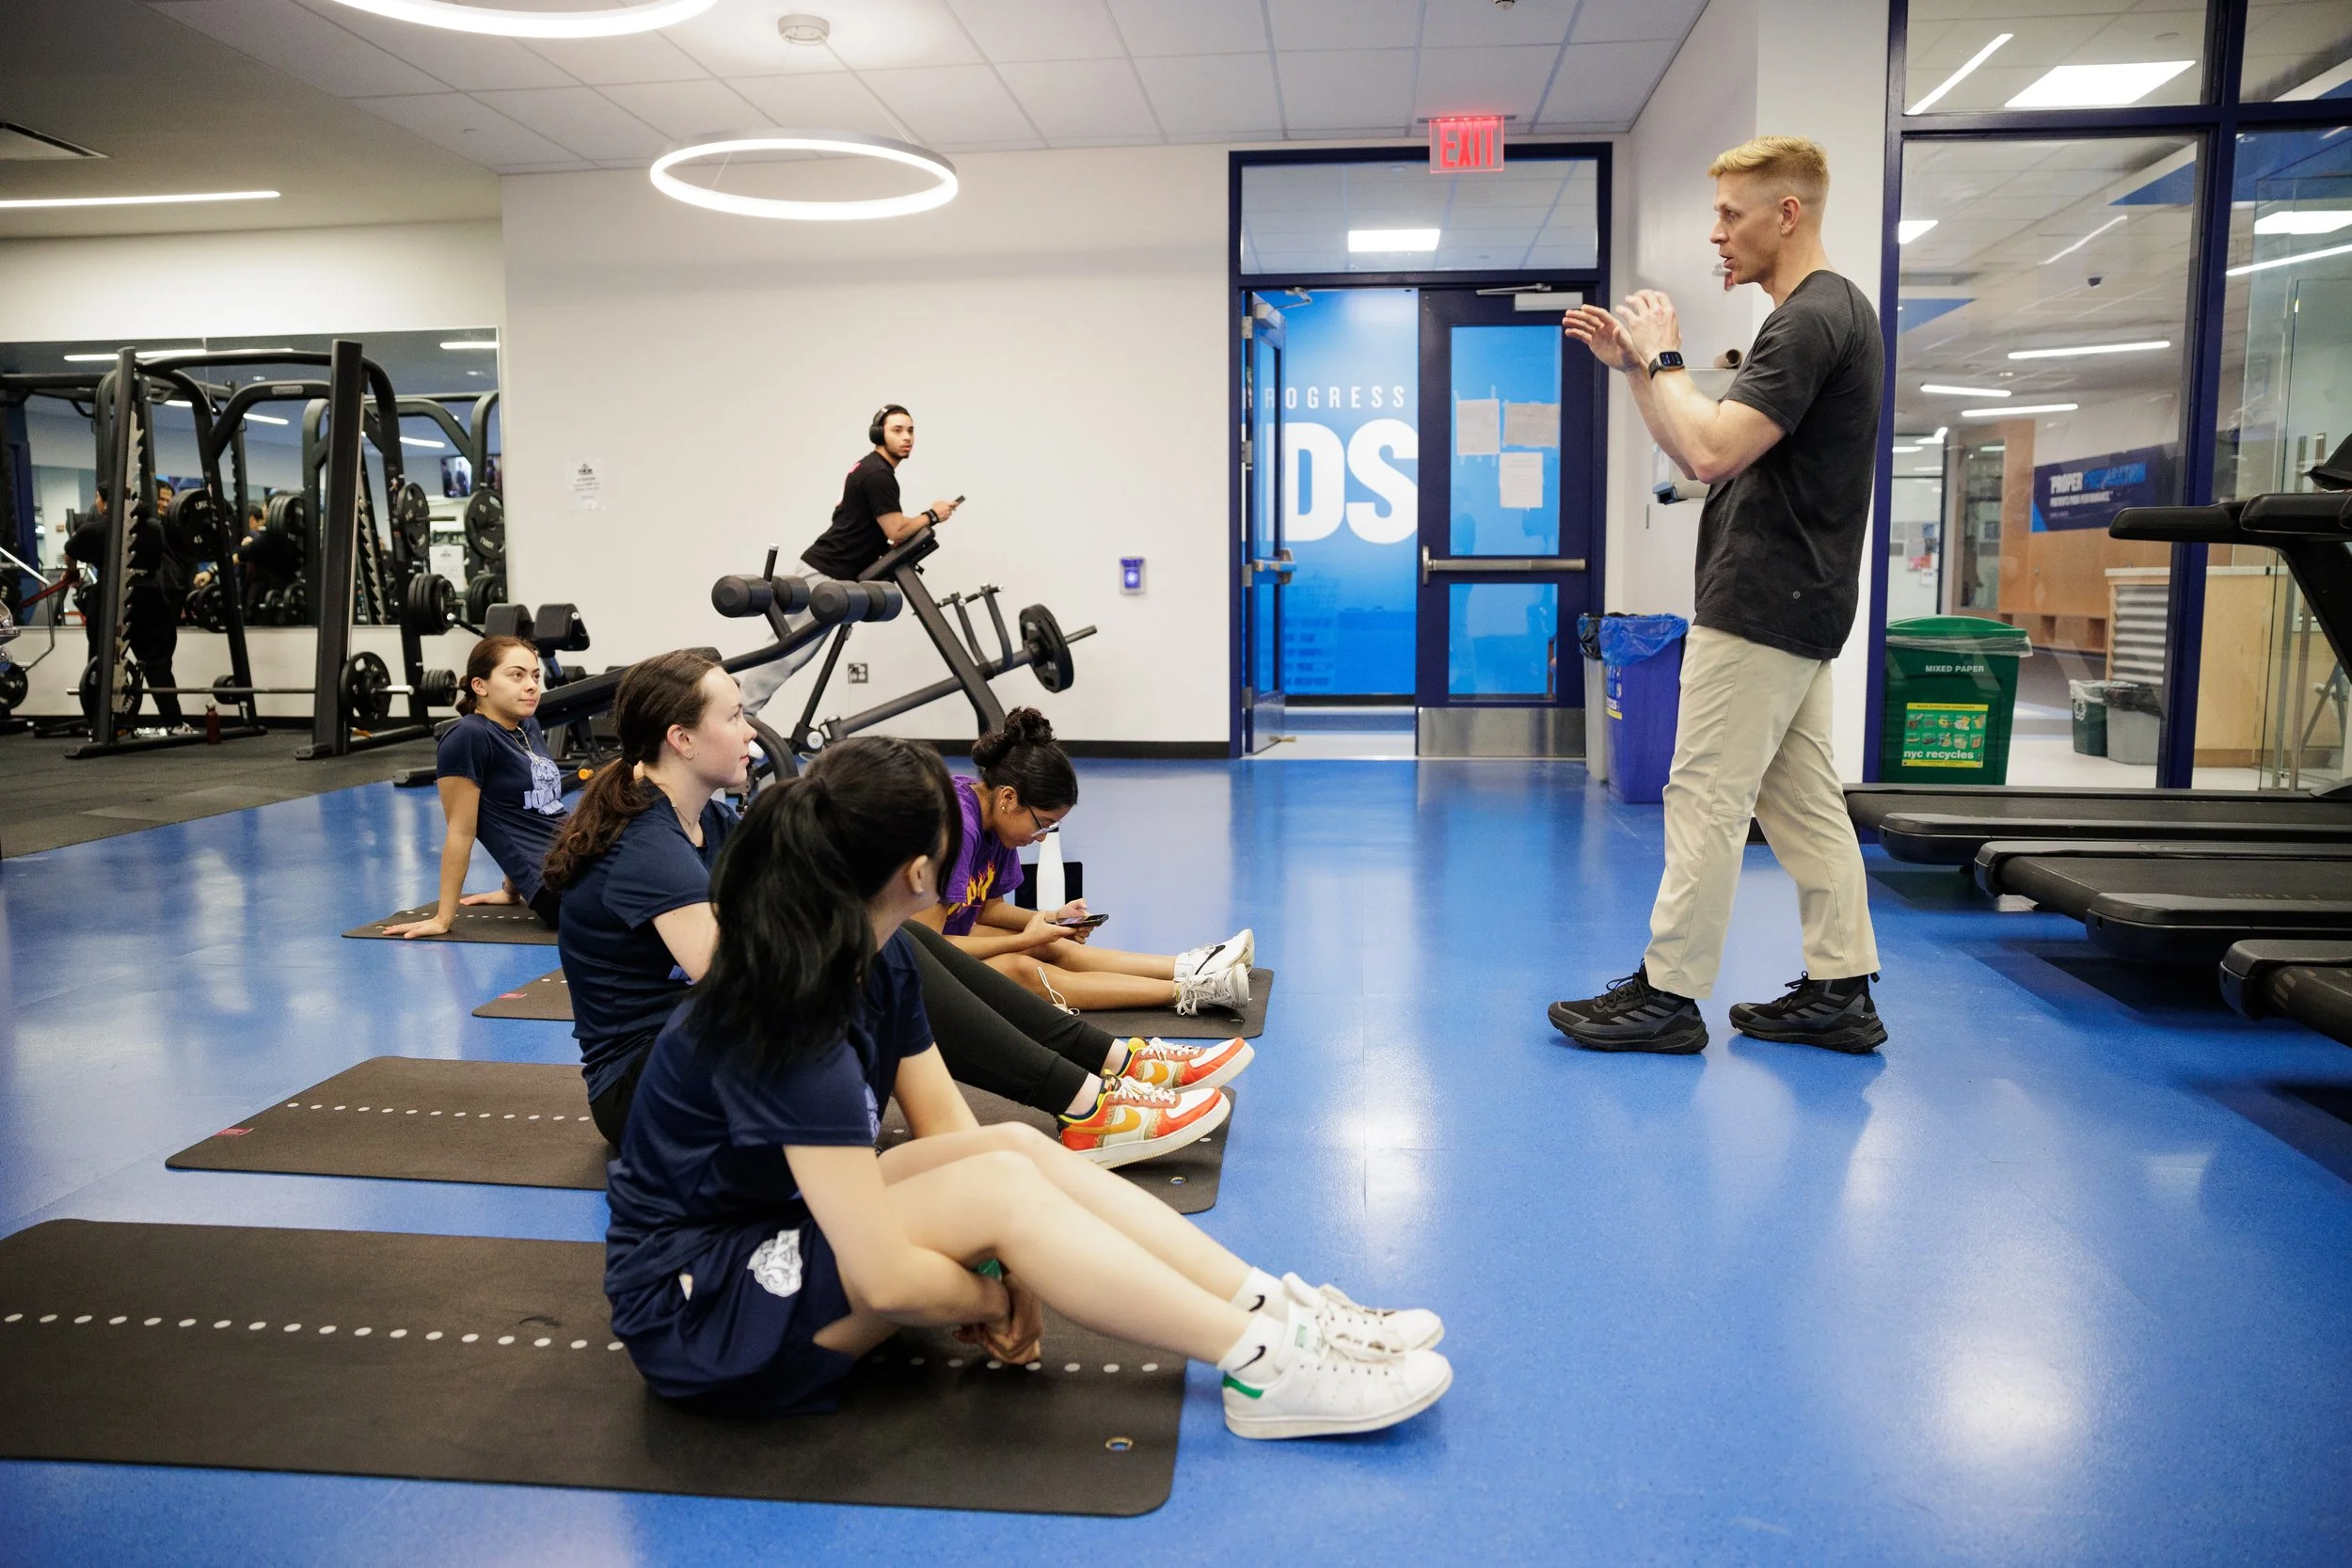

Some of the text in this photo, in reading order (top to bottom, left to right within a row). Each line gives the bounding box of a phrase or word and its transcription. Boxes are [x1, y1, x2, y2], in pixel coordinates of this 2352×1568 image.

[1440, 120, 1498, 167] EXIT
[1241, 419, 1418, 545] DS
[1925, 664, 1953, 673] MIXED
[1903, 750, 1975, 760] nyc recycles
